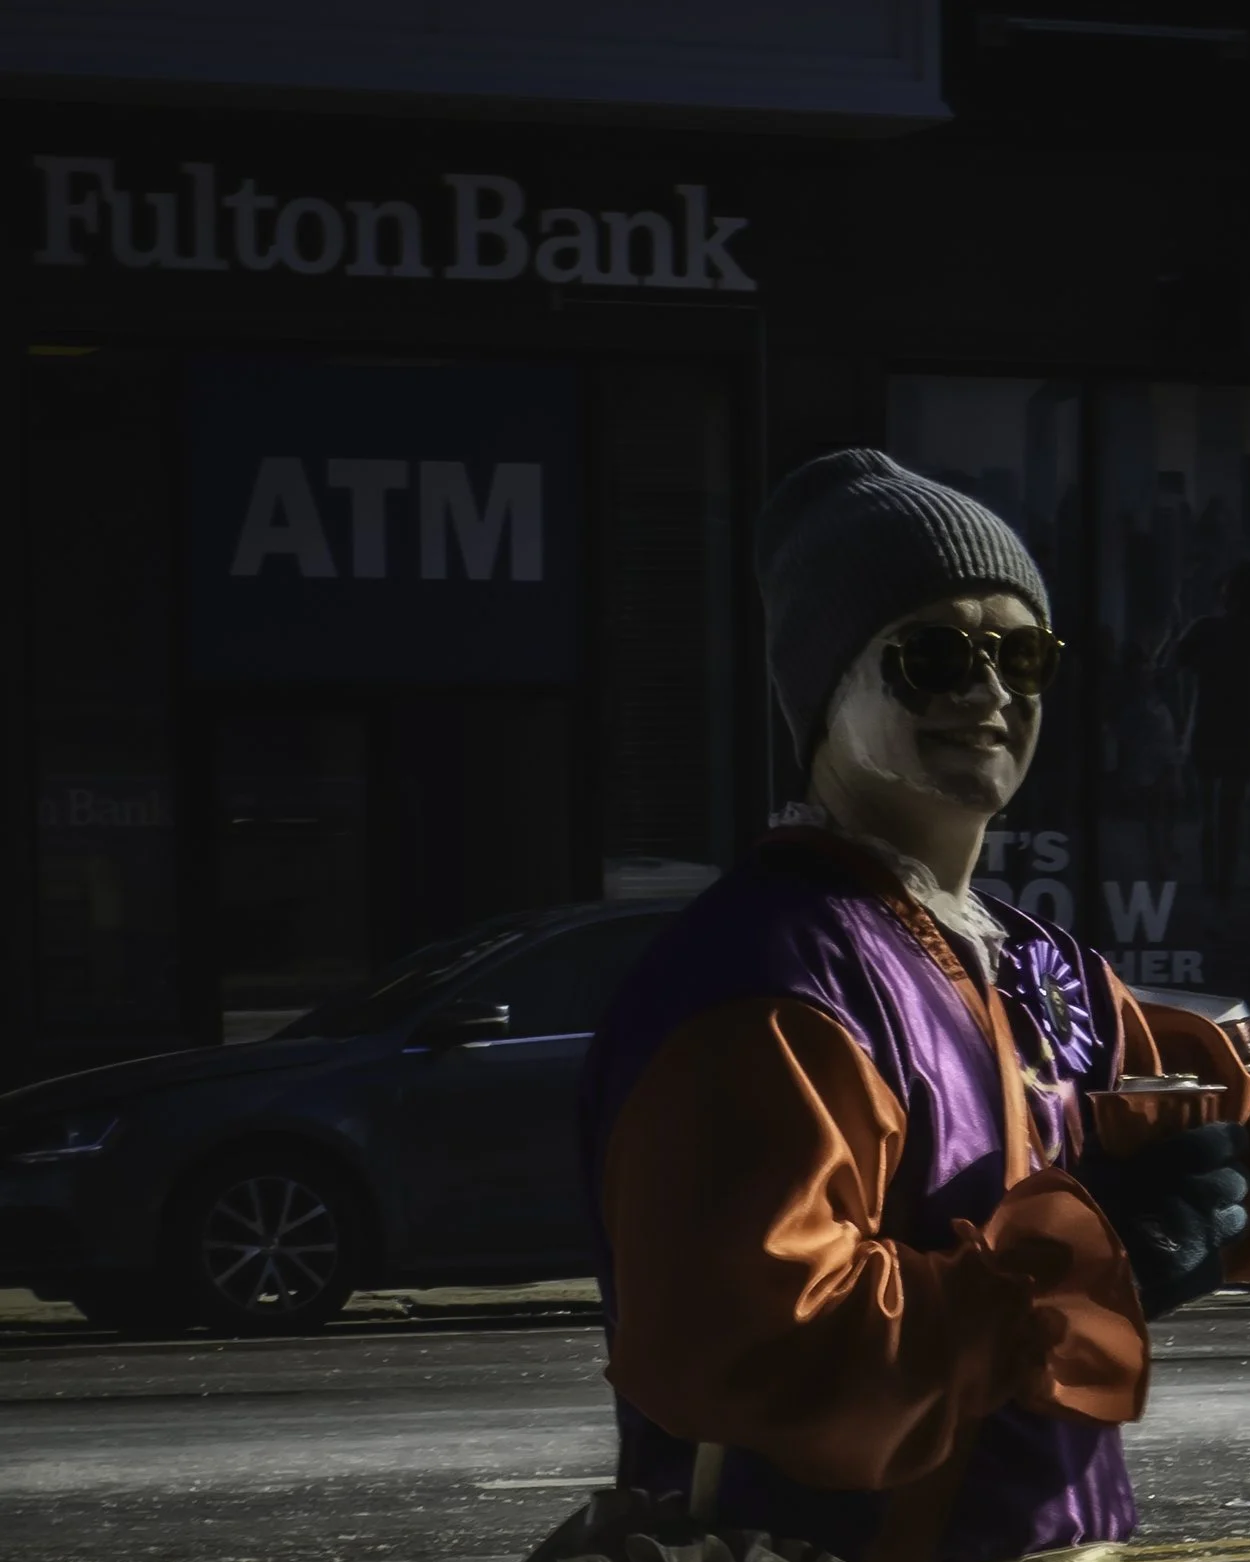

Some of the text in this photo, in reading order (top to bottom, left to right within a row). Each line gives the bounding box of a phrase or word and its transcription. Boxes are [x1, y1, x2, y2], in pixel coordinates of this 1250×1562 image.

[33, 154, 757, 291] Fulton Bank
[230, 456, 546, 583] ATM
[983, 830, 1071, 874] T'S
